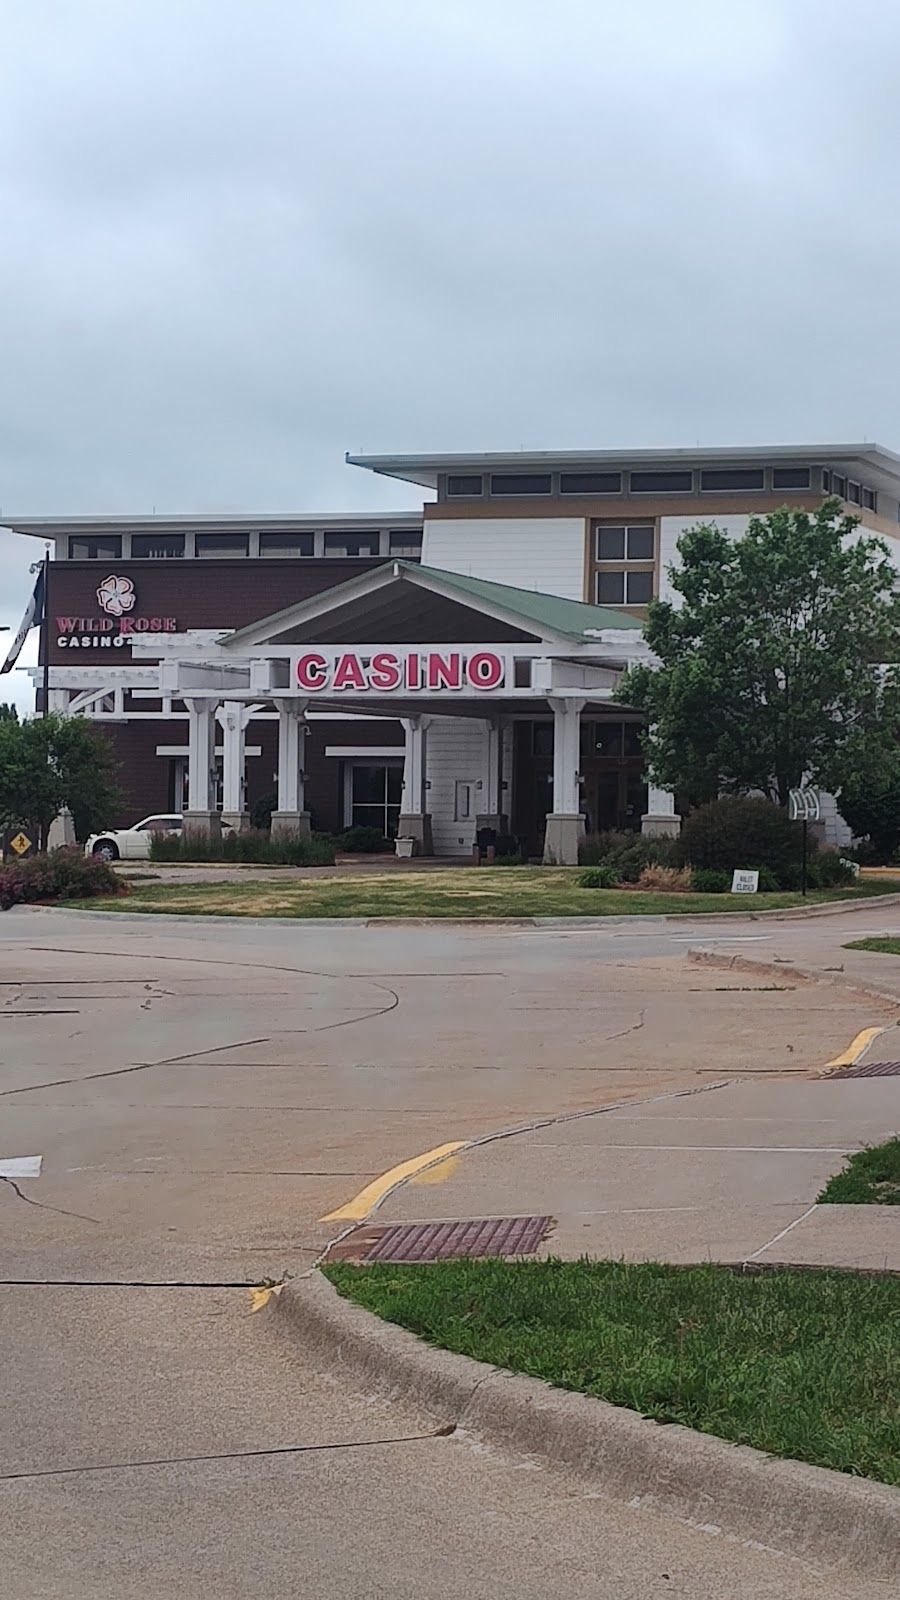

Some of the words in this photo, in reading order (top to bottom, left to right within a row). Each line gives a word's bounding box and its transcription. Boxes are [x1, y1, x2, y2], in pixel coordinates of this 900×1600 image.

[56, 616, 114, 632] WILD
[119, 616, 177, 633] ROSE
[57, 636, 125, 648] CASINO
[297, 651, 503, 690] CASINO
